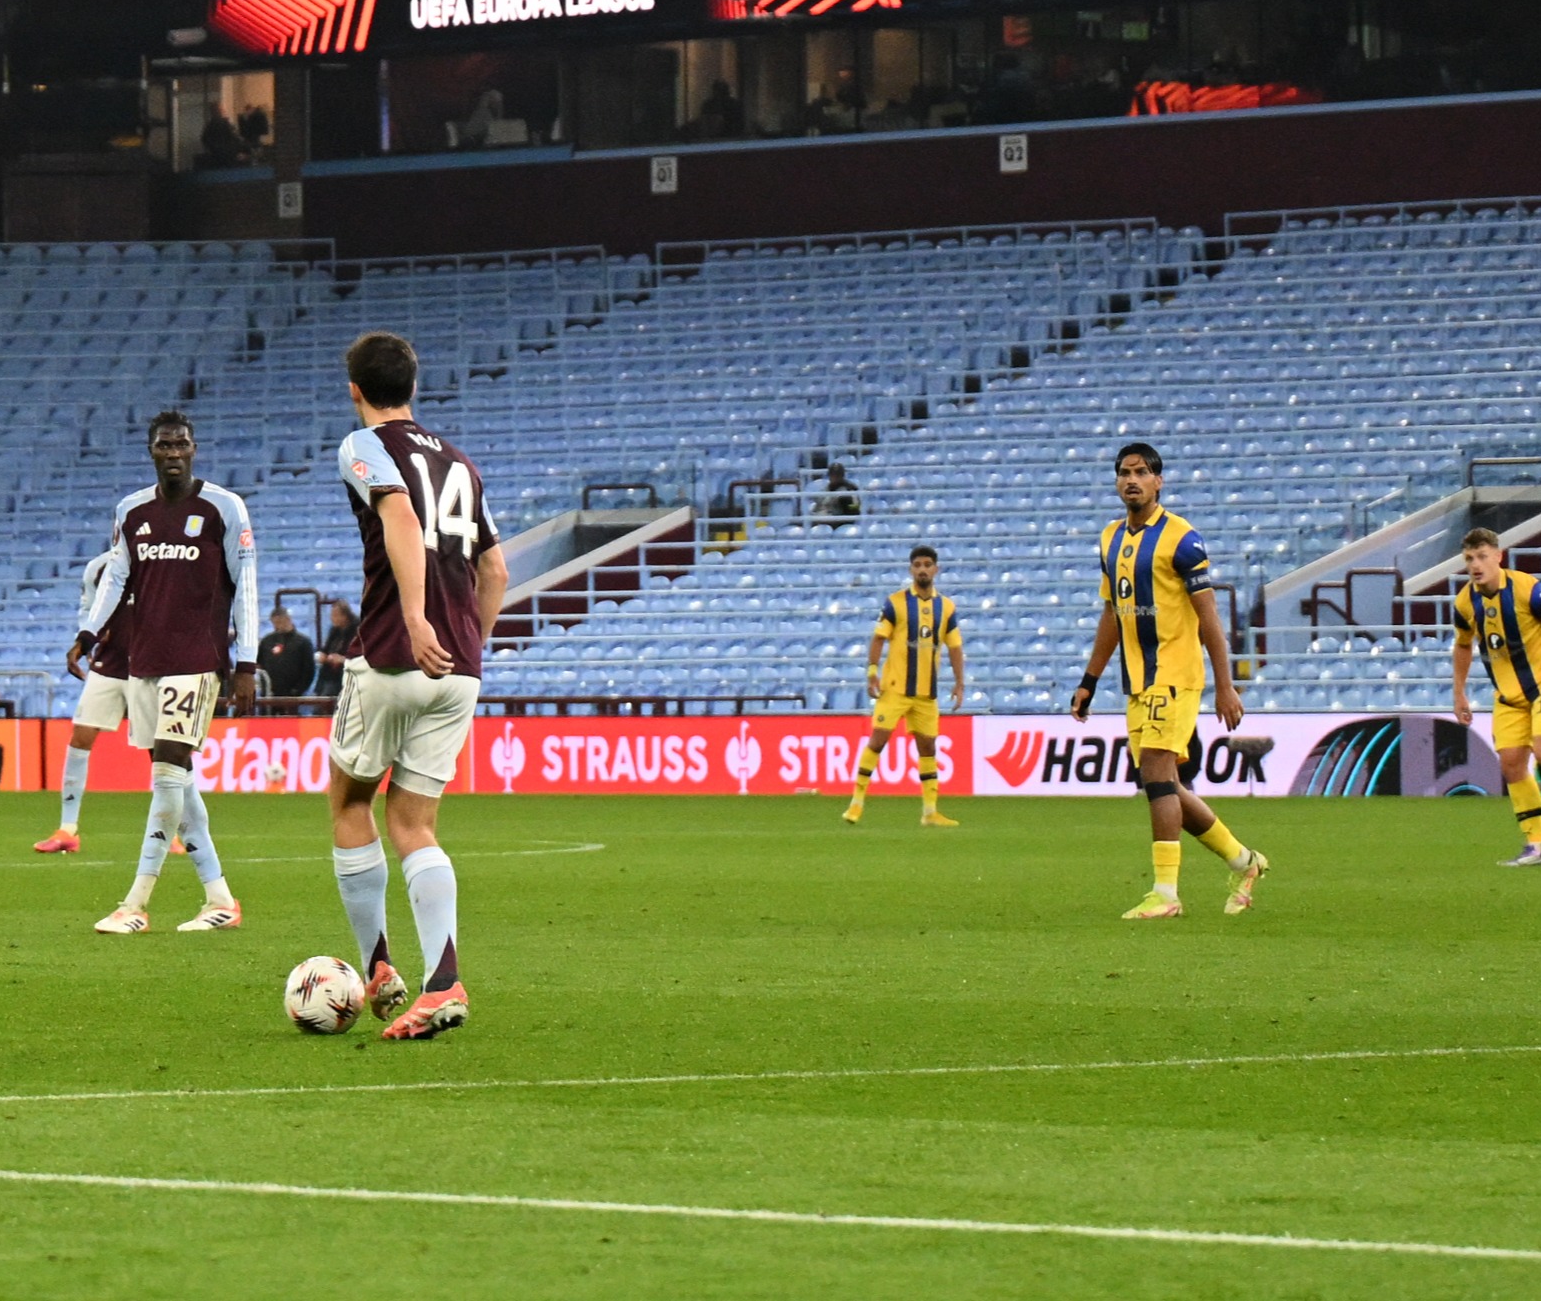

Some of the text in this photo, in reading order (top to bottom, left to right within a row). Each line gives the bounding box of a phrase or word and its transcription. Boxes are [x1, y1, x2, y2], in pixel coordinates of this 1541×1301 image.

[410, 452, 478, 560] 14
[137, 543, 200, 561] Betano
[162, 686, 195, 719] 24
[192, 726, 330, 792] etano
[542, 735, 708, 782] STRAUSS
